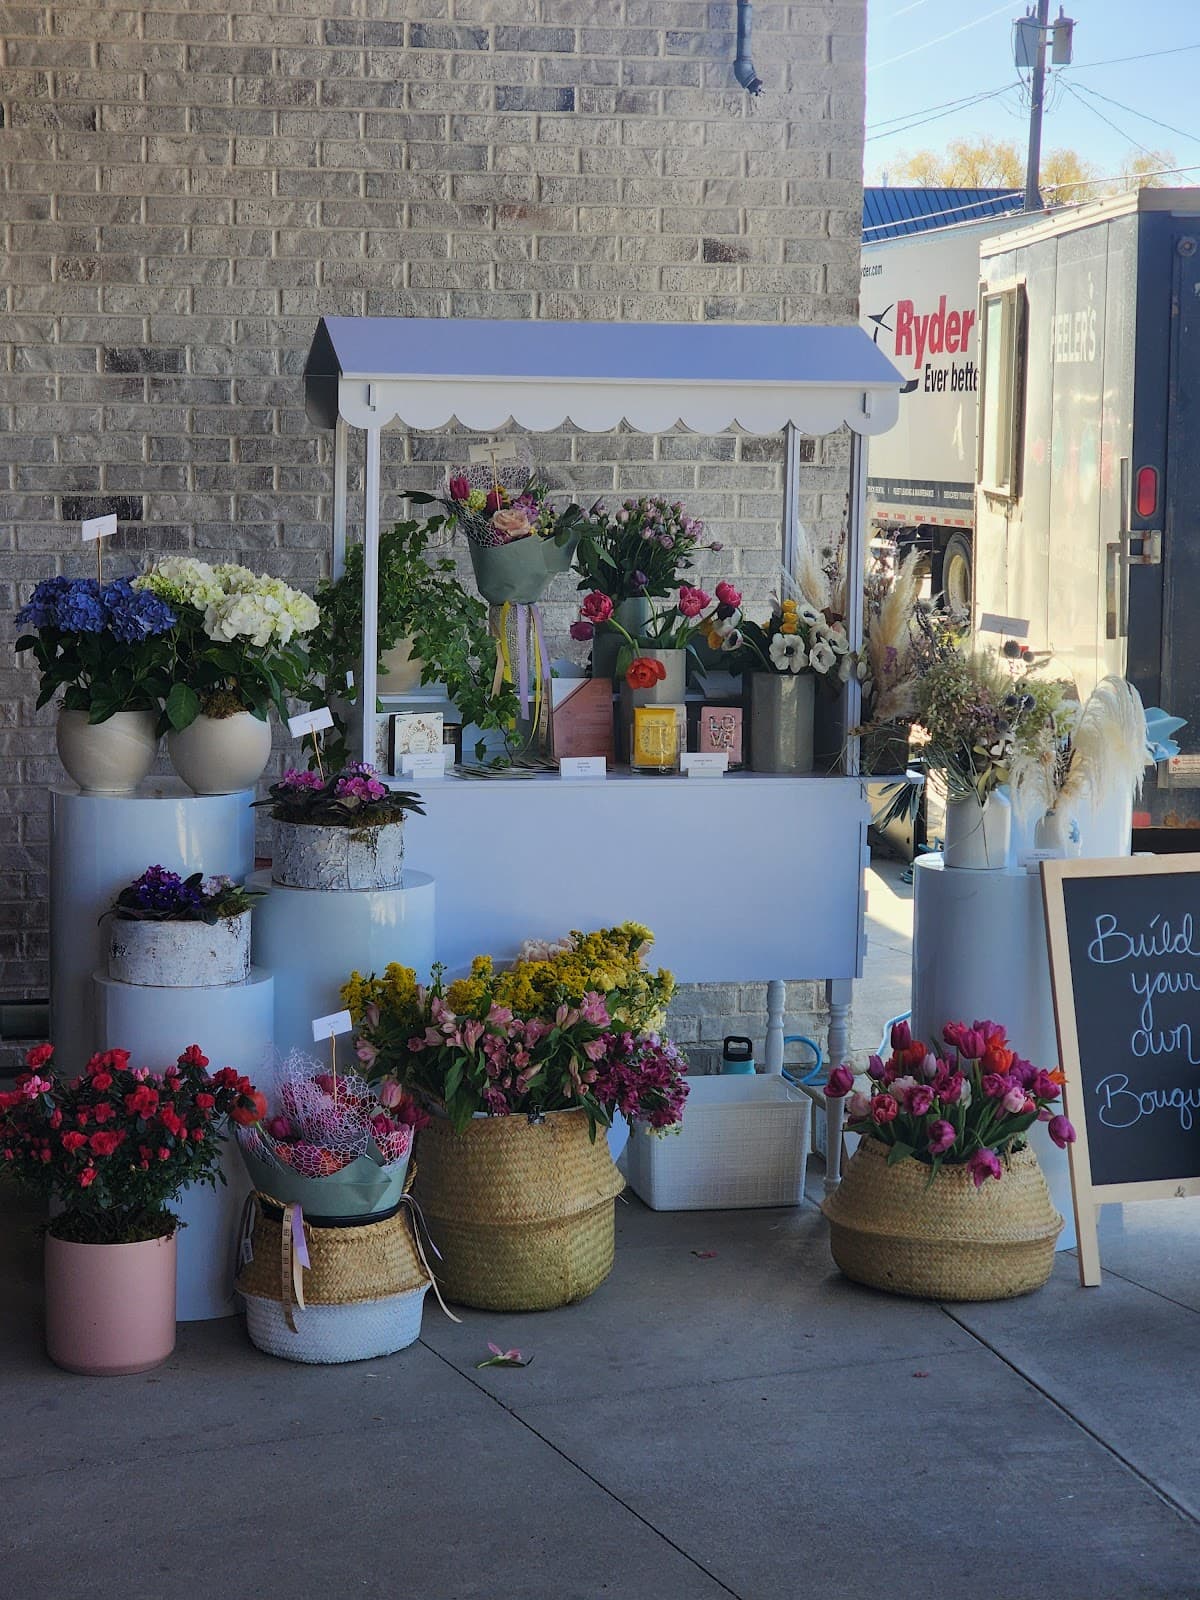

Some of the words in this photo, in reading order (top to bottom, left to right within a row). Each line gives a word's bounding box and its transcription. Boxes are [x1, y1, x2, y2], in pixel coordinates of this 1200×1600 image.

[861, 264, 883, 277] der.com
[895, 295, 975, 369] Ryder
[924, 363, 949, 392] Ever
[1088, 913, 1200, 963] Build
[1131, 972, 1200, 1032] your
[1131, 1024, 1200, 1065] own
